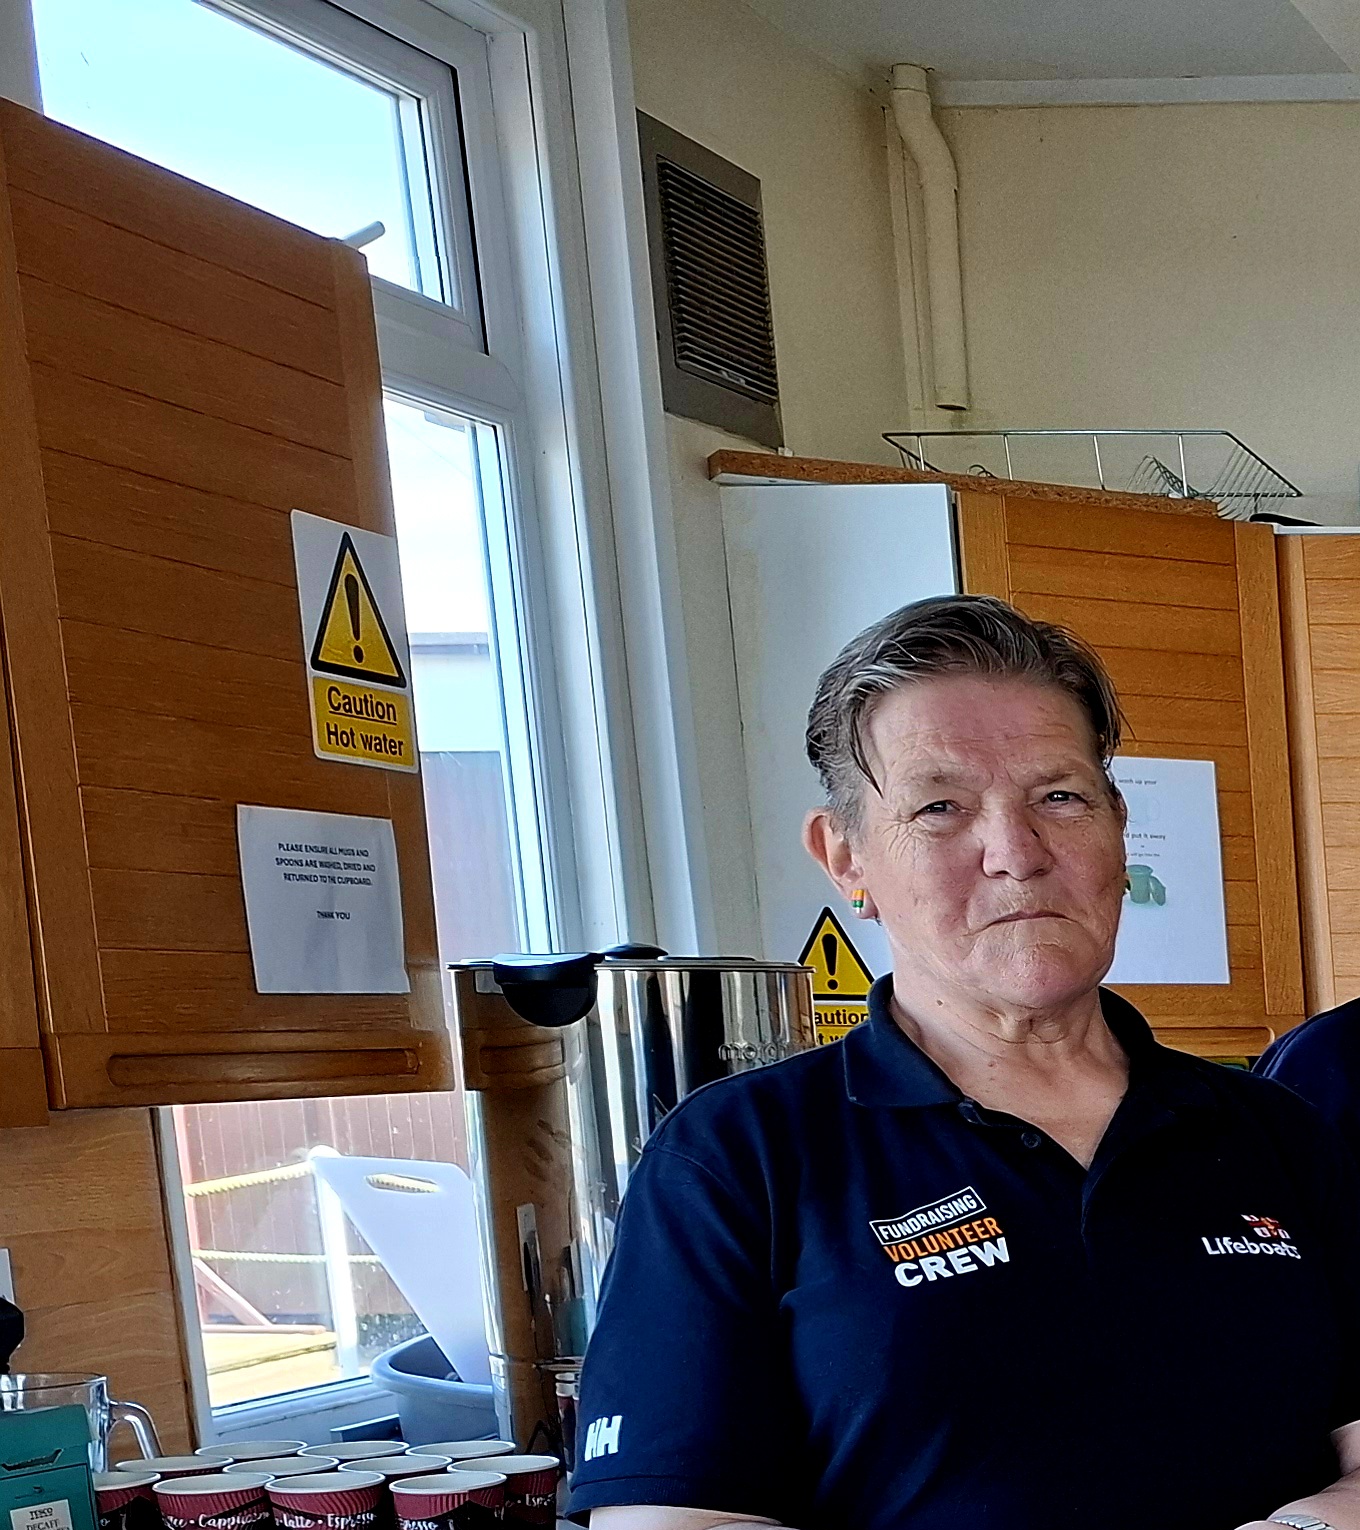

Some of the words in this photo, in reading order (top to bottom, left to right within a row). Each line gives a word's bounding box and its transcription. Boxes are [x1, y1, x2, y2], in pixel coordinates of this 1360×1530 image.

[327, 685, 397, 722] Caution
[326, 721, 356, 748] Hot
[360, 731, 404, 756] water
[278, 843, 304, 853] PLEASE
[275, 857, 304, 867] SPOONS
[305, 859, 318, 868] ARE
[362, 864, 376, 872] AND
[283, 872, 319, 883] RETURNED
[335, 912, 351, 920] YOU
[815, 1008, 869, 1025] aution
[878, 1194, 978, 1240] FUNDRAISING
[883, 1217, 1004, 1262] VOLUNTEER
[1201, 1236, 1301, 1259] Lifeboats
[894, 1236, 1010, 1288] CREW
[584, 1415, 623, 1462] HH
[29, 1507, 53, 1520] TESCO
